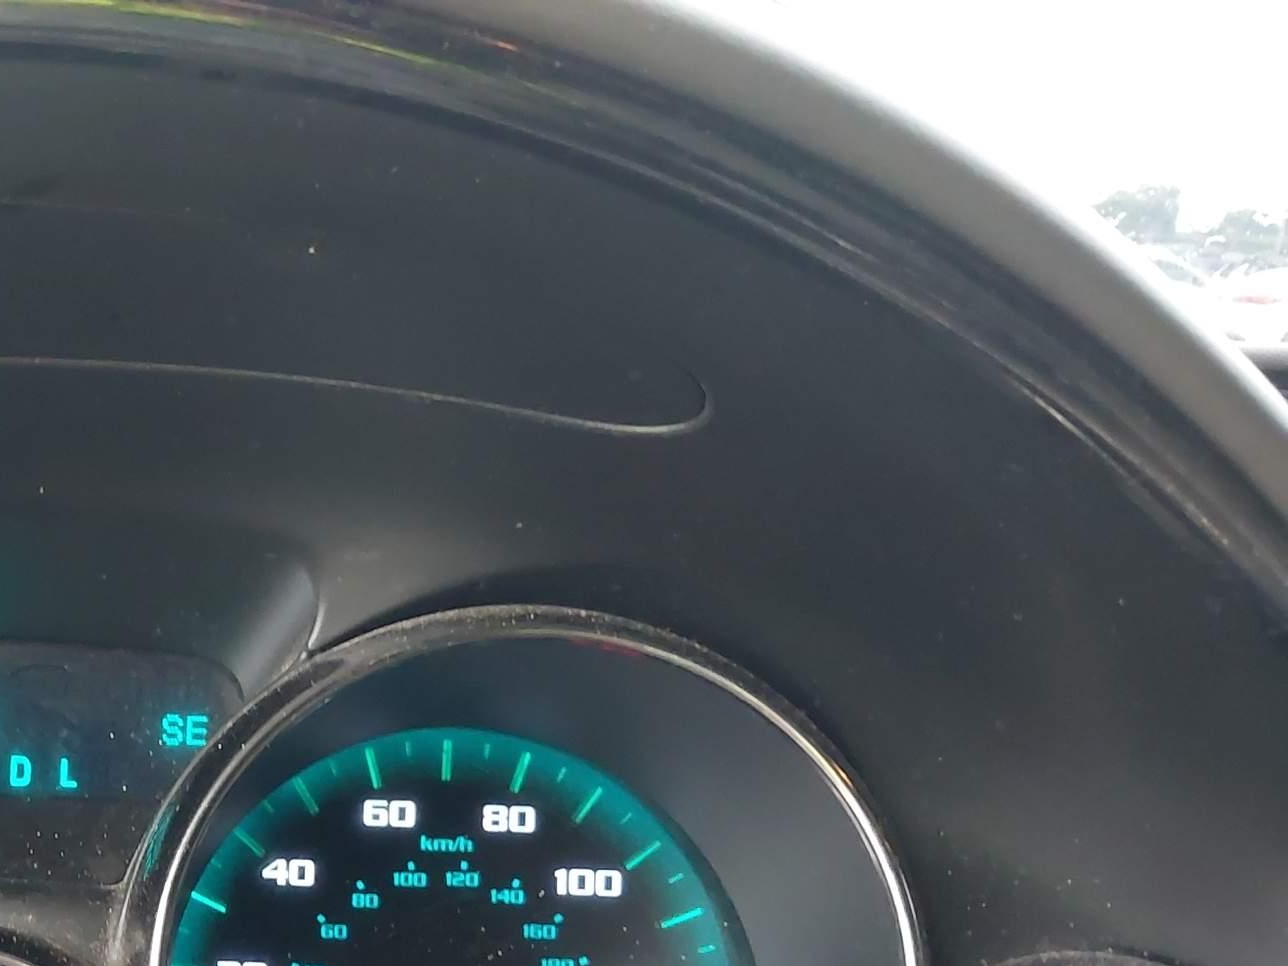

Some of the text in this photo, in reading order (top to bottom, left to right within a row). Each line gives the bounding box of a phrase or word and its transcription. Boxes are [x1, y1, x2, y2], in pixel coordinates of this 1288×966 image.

[161, 714, 208, 747] SE
[9, 754, 32, 788] D
[59, 757, 78, 789] L
[362, 799, 417, 829] 60
[482, 804, 537, 834] 80
[420, 835, 473, 852] km/h
[261, 858, 316, 887] 40
[393, 871, 427, 888] 100
[445, 870, 480, 888] 120
[554, 868, 623, 898] 100
[490, 888, 525, 906] 140
[320, 923, 348, 940] 60
[523, 924, 557, 940] 160
